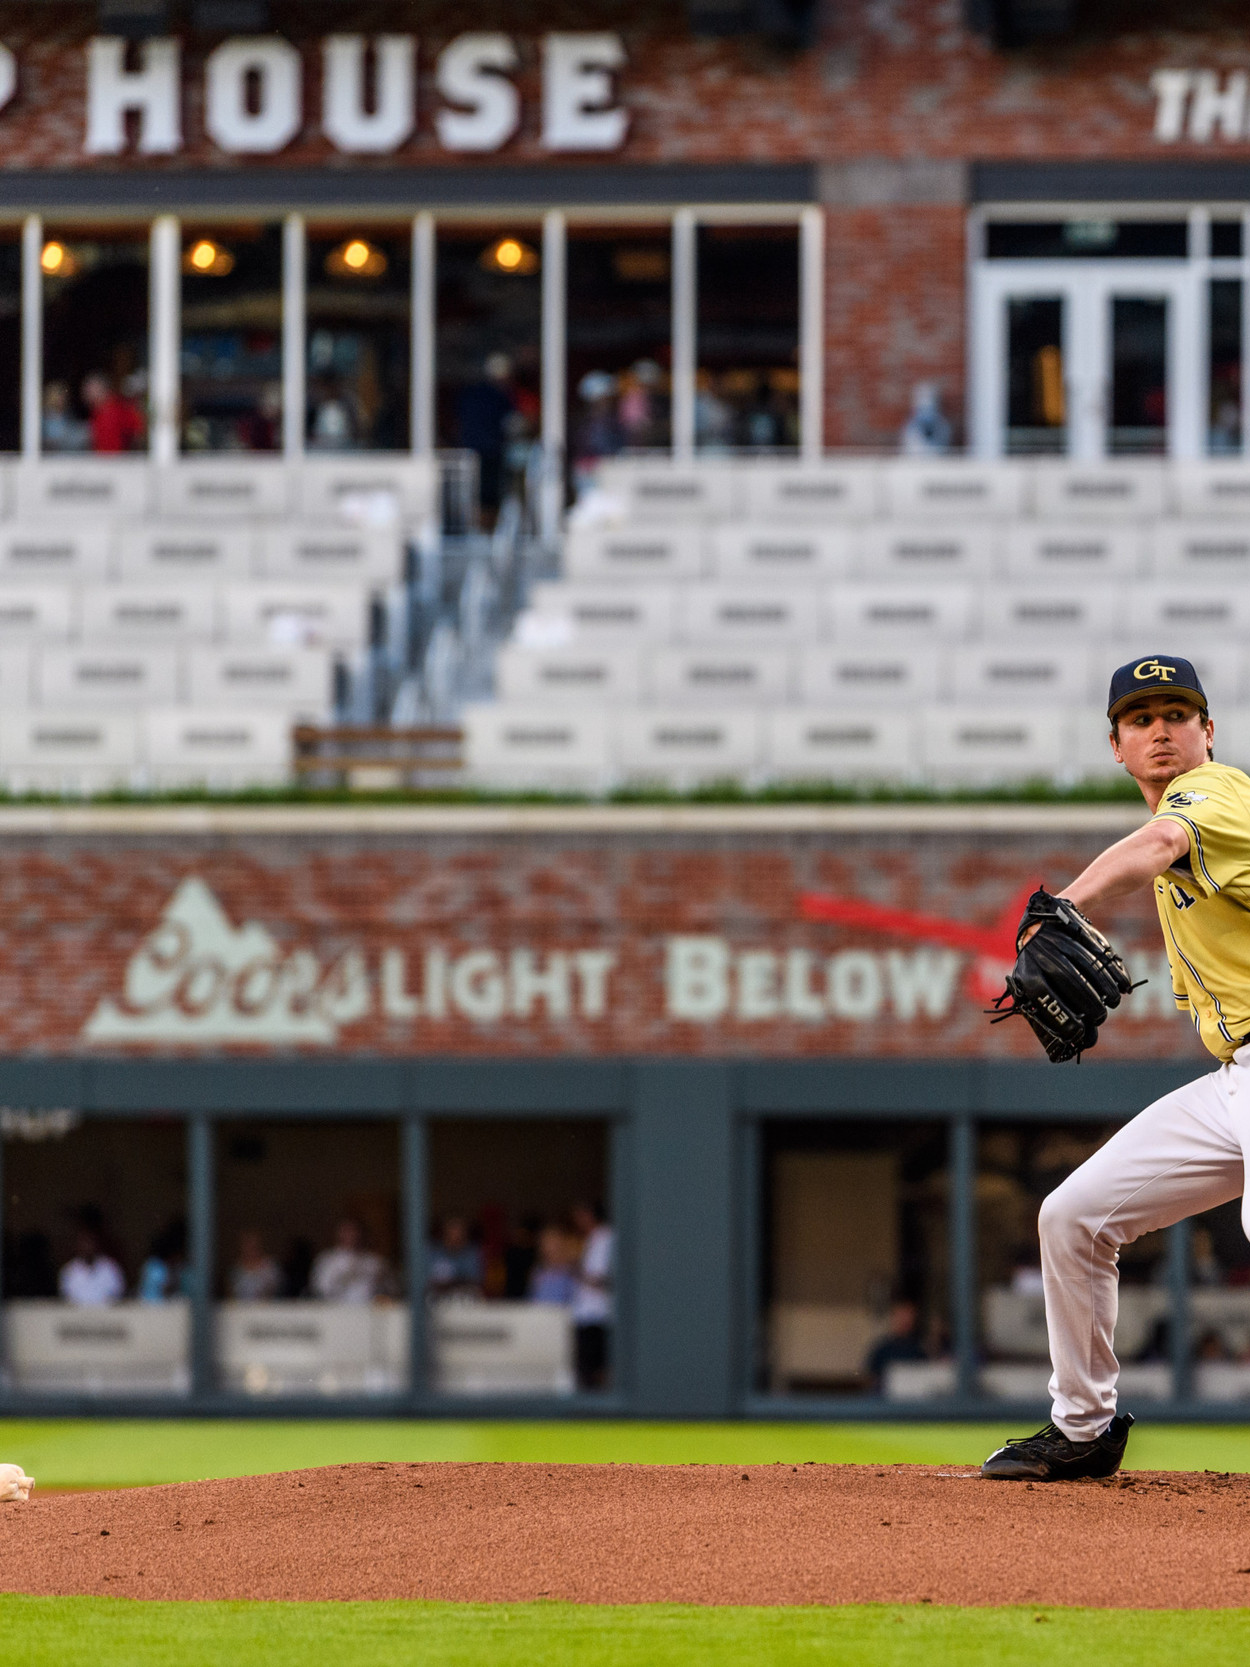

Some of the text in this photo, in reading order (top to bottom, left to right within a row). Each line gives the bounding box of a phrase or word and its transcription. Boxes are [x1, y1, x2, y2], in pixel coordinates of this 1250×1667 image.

[82, 31, 630, 155] HOUSE
[1133, 659, 1177, 682] GT
[117, 912, 618, 1024] Coors LIGHT
